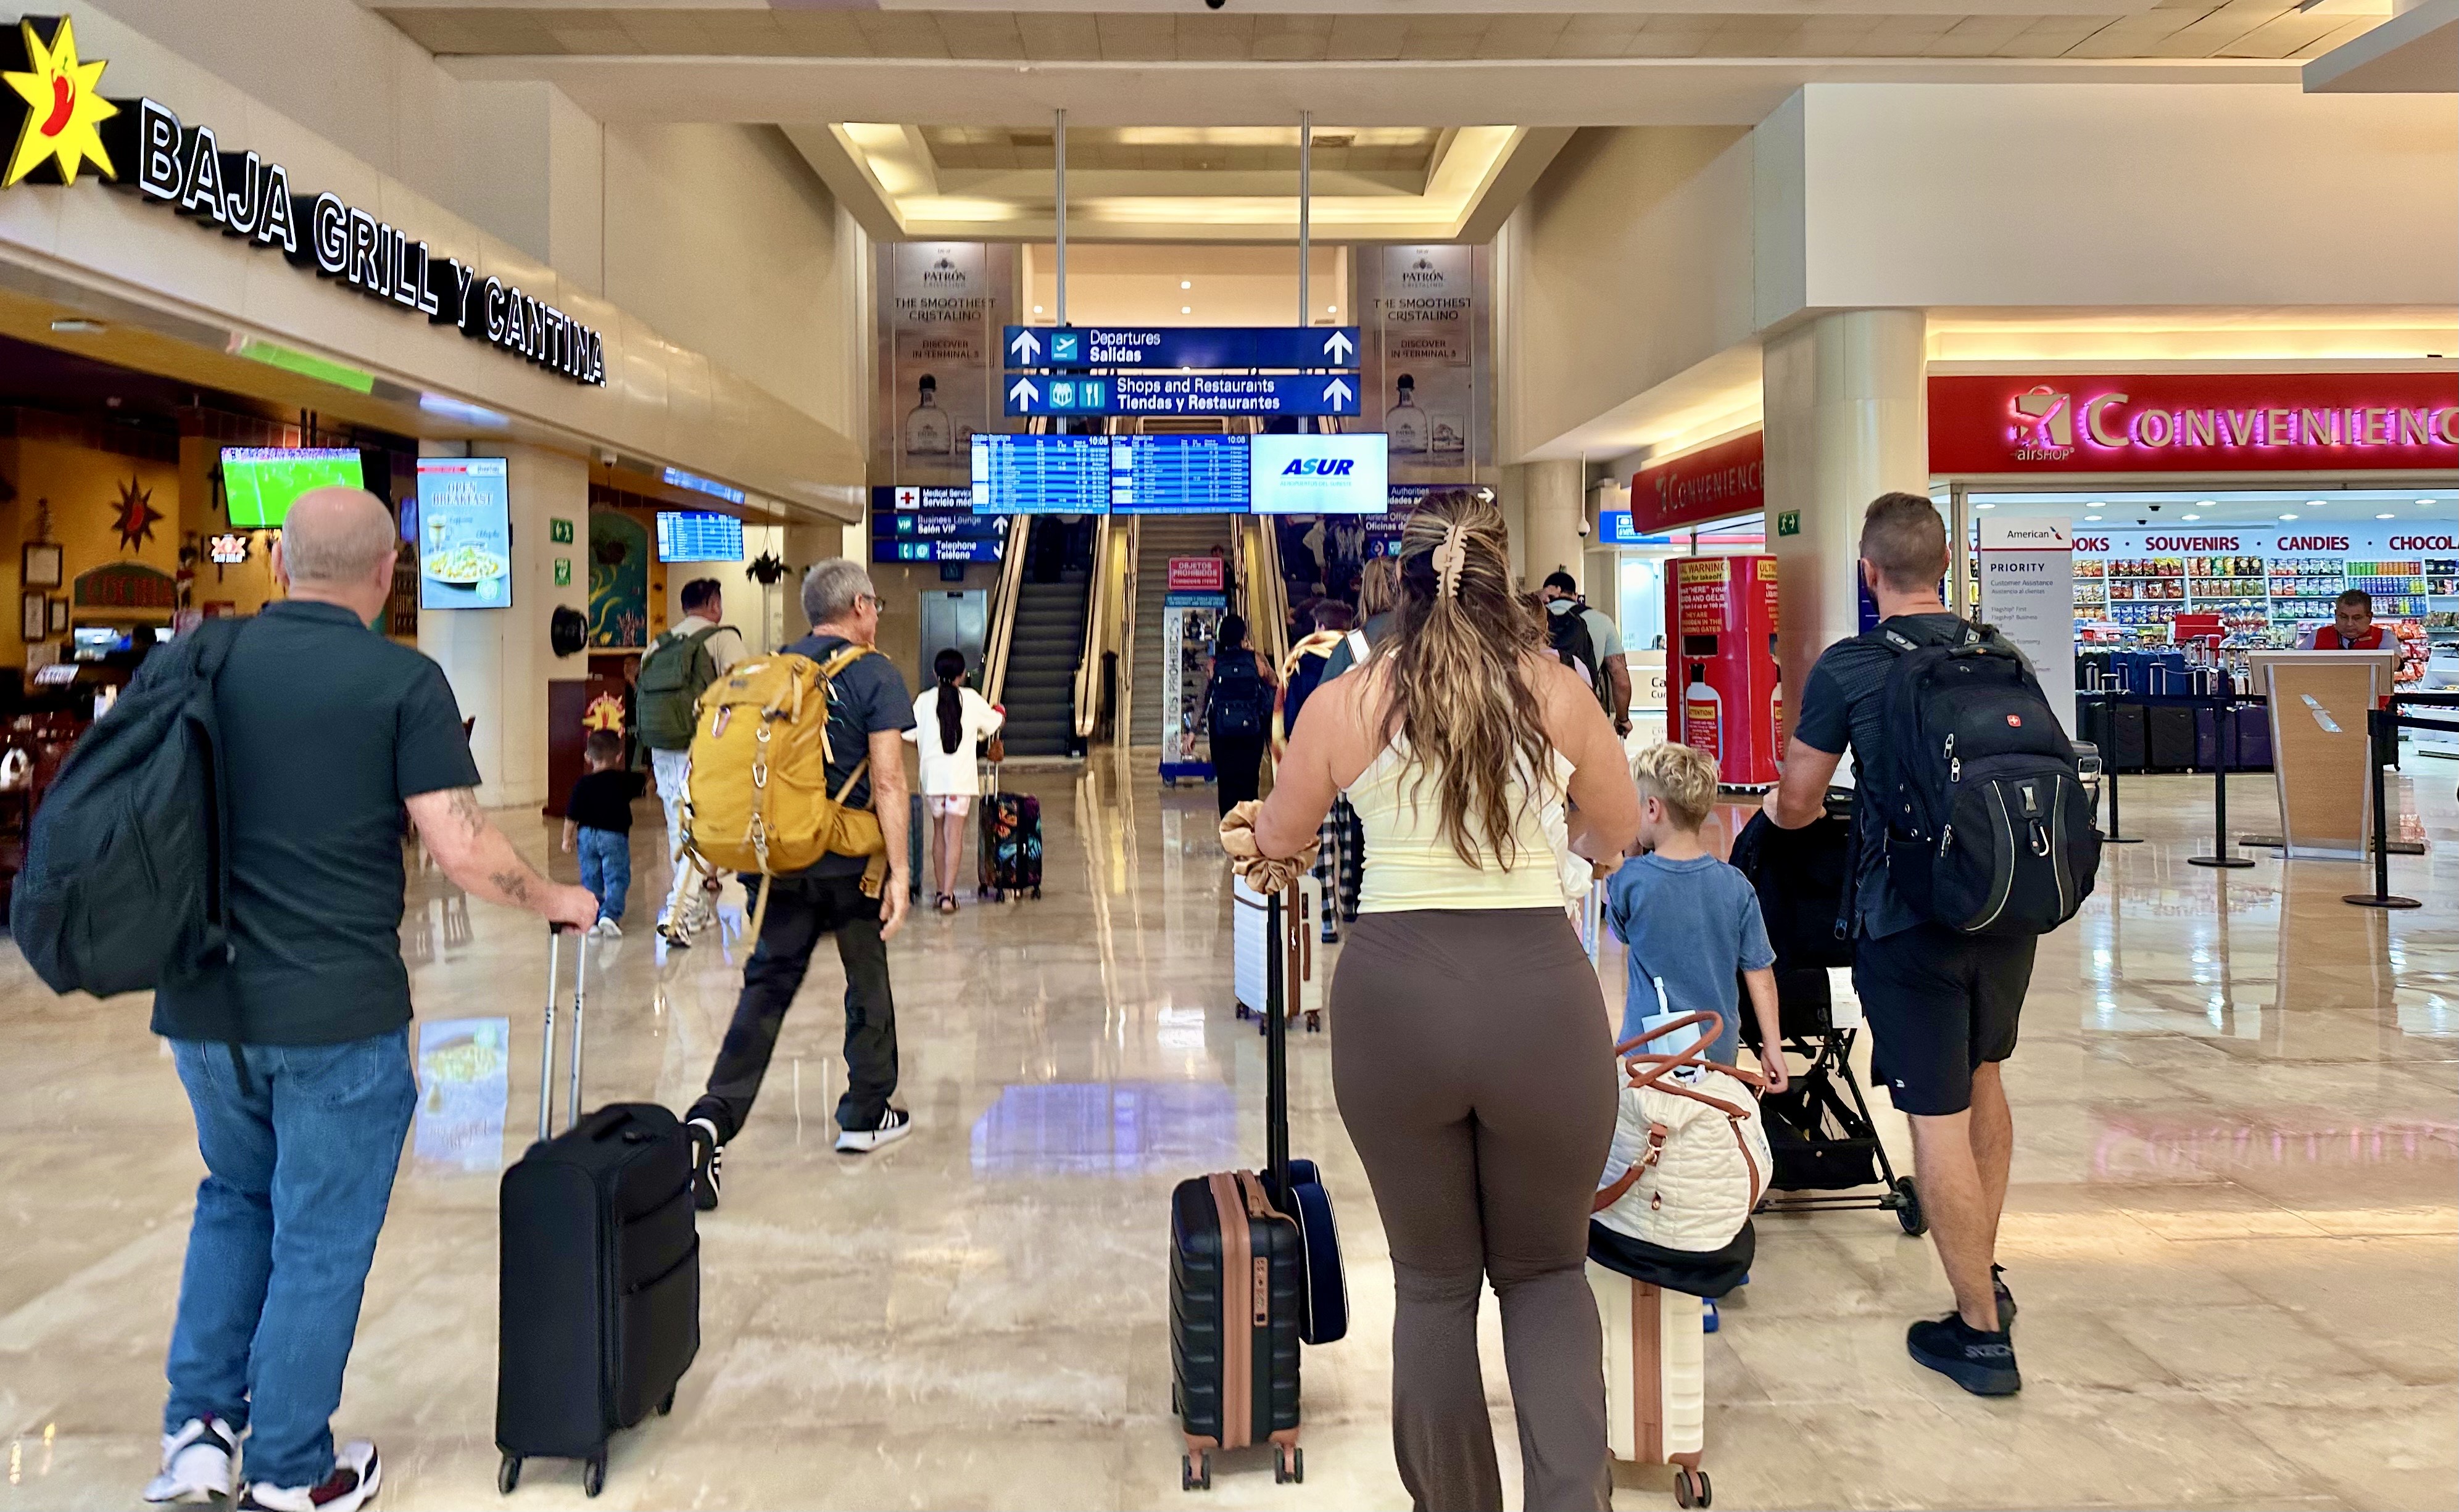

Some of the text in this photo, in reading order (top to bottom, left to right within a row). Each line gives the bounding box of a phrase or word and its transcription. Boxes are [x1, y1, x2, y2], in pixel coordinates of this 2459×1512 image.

[140, 97, 606, 387] BAJA GRILL Y CANTINA
[1403, 269, 1444, 282] PATRÓN
[895, 298, 997, 308] THE SMOOTHEST
[1399, 298, 1471, 308] SMOOTHEST
[909, 311, 981, 321] CRISTALINO
[1388, 310, 1458, 321] CRISTALINO
[1090, 329, 1161, 348] Departures
[923, 341, 969, 349] DISCOVER
[1401, 340, 1446, 349] DISCOVER
[1090, 347, 1142, 363] Salidas
[1403, 350, 1448, 358] TERMINAL
[1117, 377, 1275, 395] Shops and Restaurants
[1117, 394, 1280, 413] Tiendas y Restaurantes
[1227, 436, 1246, 444] 10:08
[1280, 458, 1354, 476] ASUR
[447, 481, 477, 494] OPEN
[923, 488, 972, 498] Medical Servic
[1391, 486, 1430, 495] Authorities
[432, 492, 493, 506] BREAKFAST
[923, 497, 972, 507] Servicio méd
[918, 514, 981, 526] Business Lounge
[1390, 512, 1410, 522] Offic
[898, 520, 911, 529] VIP
[918, 523, 956, 534] Salón VIP
[1366, 521, 1397, 531] Oficinas
[2007, 530, 2049, 539] American
[936, 540, 977, 552] Telephone
[2072, 537, 2110, 552] OKS
[2146, 536, 2240, 551] SOUVENIRS
[2277, 536, 2350, 551] CANDIES
[2389, 535, 2459, 551] CHOCOL
[936, 550, 971, 560] Teléfono
[1990, 563, 2045, 572] PRIORITY
[1651, 677, 1667, 688] Ca
